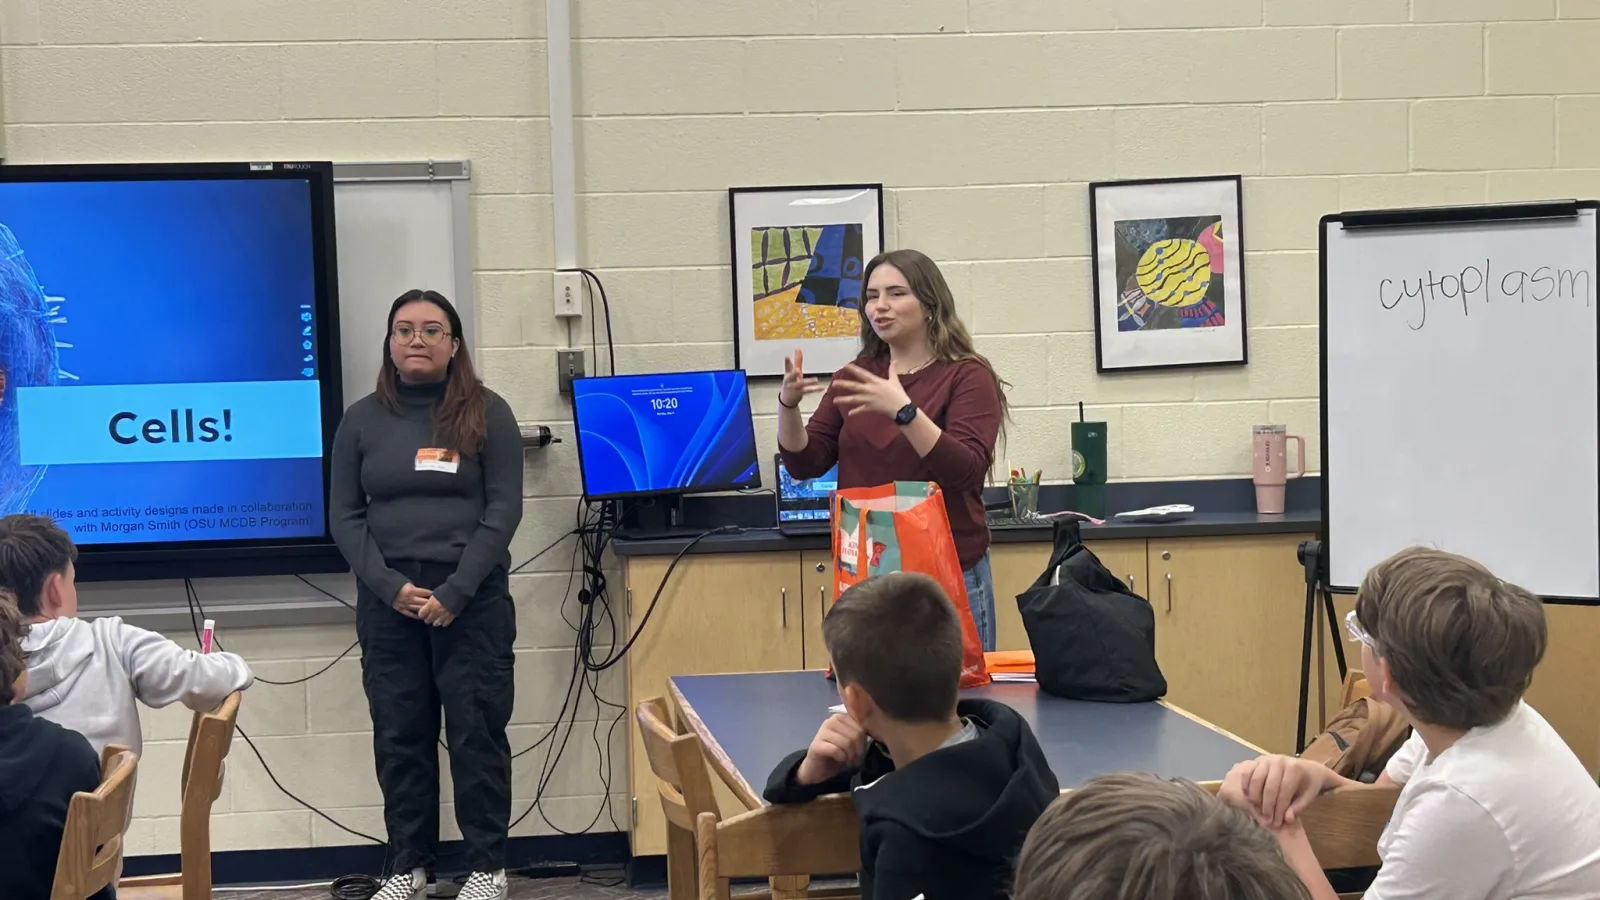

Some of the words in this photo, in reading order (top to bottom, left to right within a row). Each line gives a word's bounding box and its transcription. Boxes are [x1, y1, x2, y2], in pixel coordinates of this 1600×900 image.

[1379, 258, 1590, 331] cytoplasm
[650, 397, 678, 410] 10:20
[108, 408, 233, 445] Cells!
[40, 508, 73, 519] slides
[77, 507, 98, 518] and
[101, 506, 141, 518] activity
[144, 505, 188, 517] designs
[192, 504, 223, 515] made
[227, 503, 237, 513] in
[240, 502, 312, 513] collaboration
[74, 522, 98, 533] with
[101, 521, 144, 533] Morgan
[148, 519, 180, 531] Smith
[184, 518, 216, 531] (OSU
[219, 517, 256, 529] MCDB
[260, 515, 313, 528] Program)
